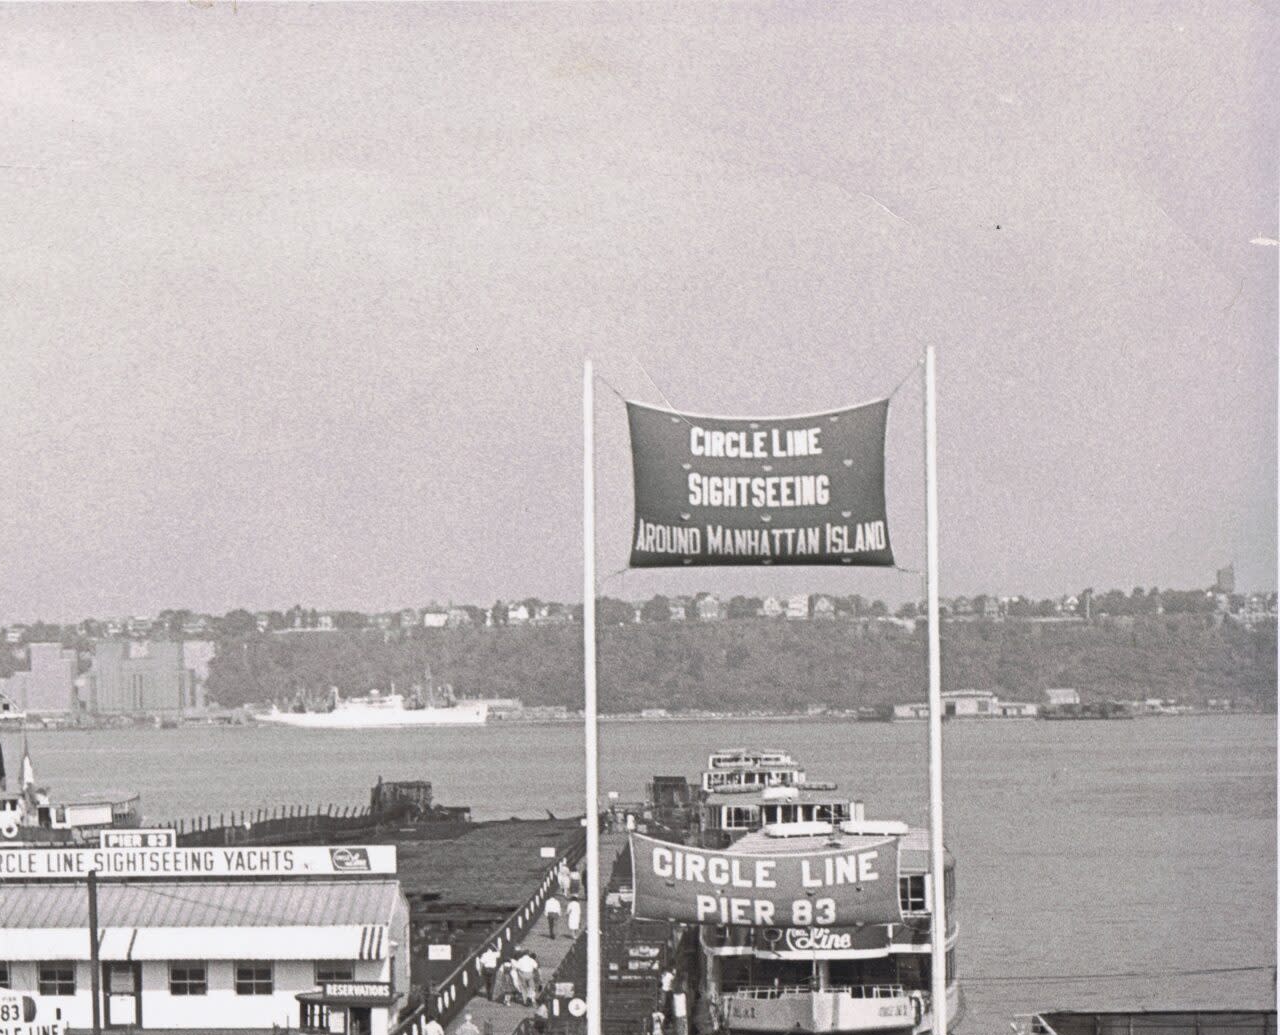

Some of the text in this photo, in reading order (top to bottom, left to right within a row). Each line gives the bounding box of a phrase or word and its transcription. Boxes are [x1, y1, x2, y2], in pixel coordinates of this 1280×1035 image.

[690, 427, 822, 458] CIRCLE LINE
[688, 472, 830, 507] SIGHTSEEING
[636, 518, 886, 556] AROUND MANHATTAN ISLAND
[108, 834, 142, 847] PIER
[47, 852, 85, 873] LINE
[94, 851, 215, 873] SIGHTSEEING
[224, 850, 295, 871] YACHTS
[652, 847, 879, 888] CIRCLE LINE
[696, 895, 836, 925] PIER 83
[795, 927, 851, 949] Line
[326, 984, 390, 997] RESERVATIONS
[0, 1004, 20, 1021] 83
